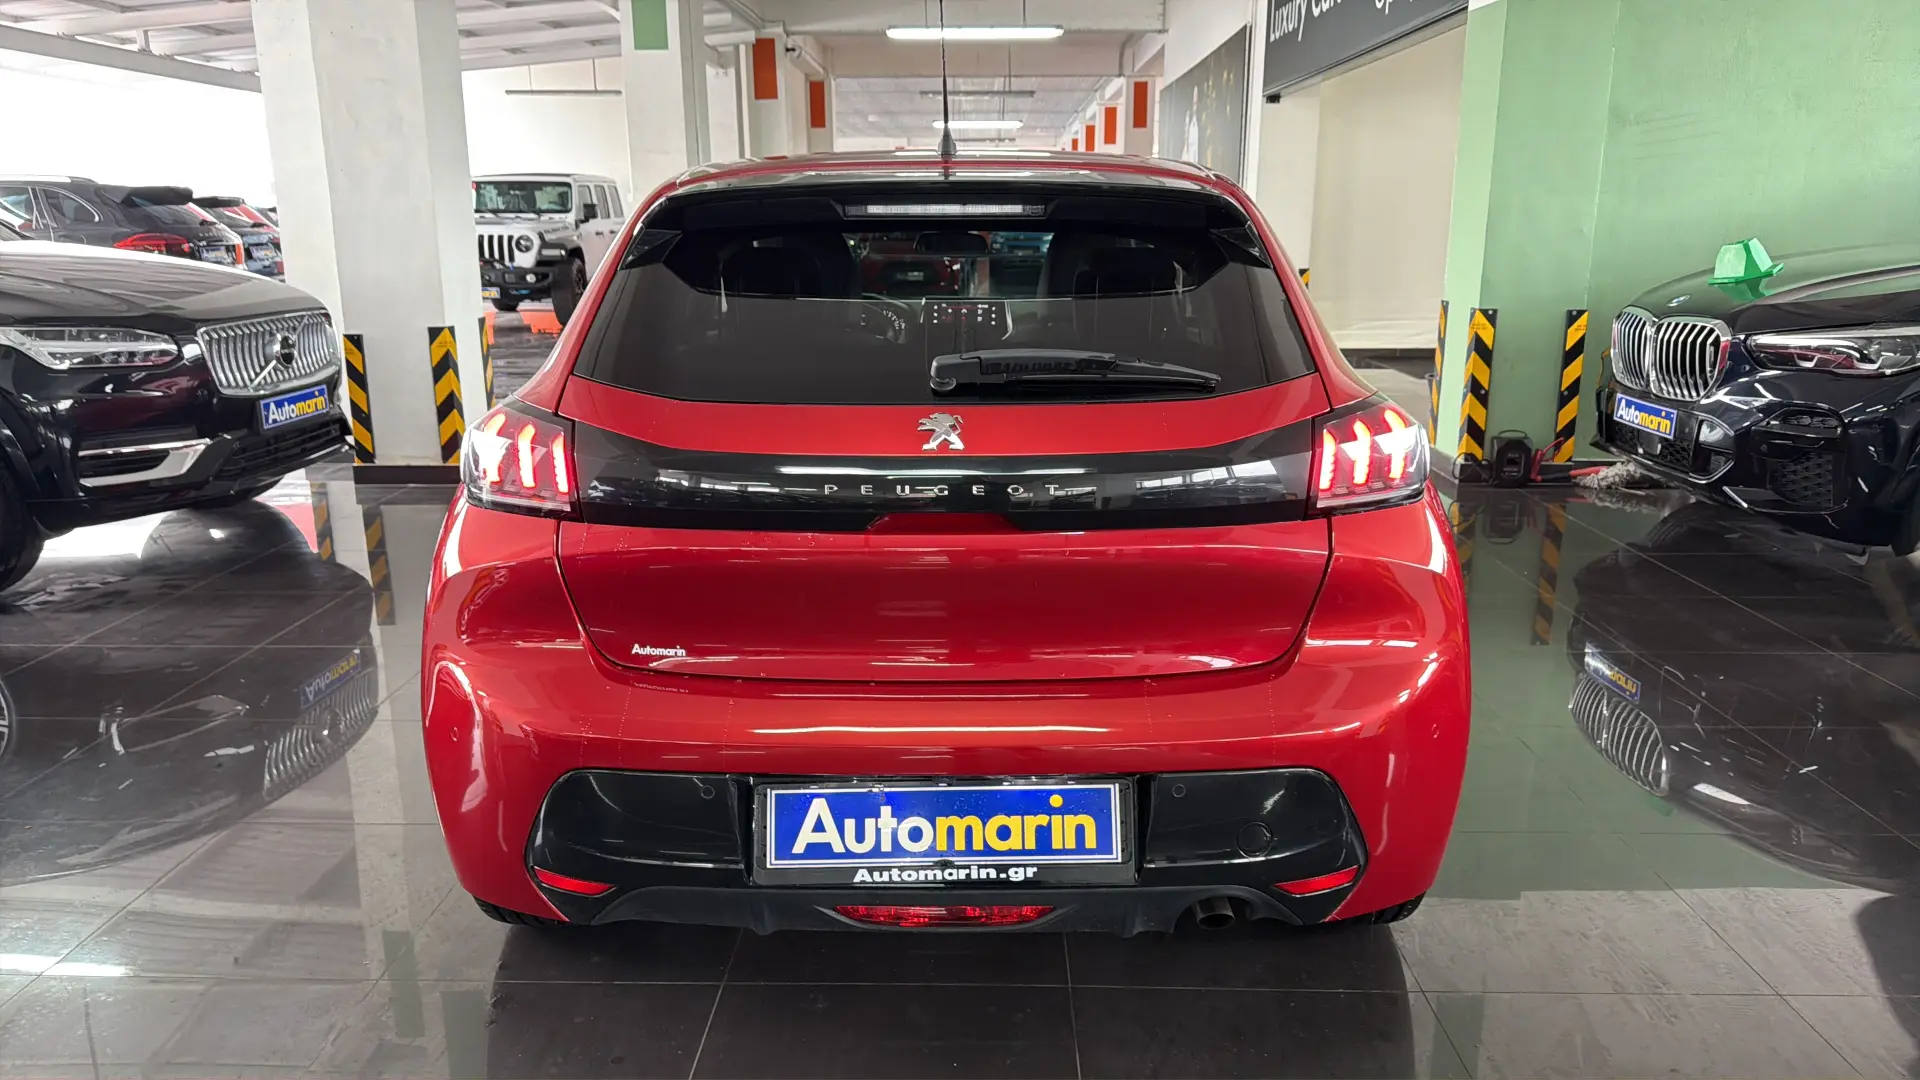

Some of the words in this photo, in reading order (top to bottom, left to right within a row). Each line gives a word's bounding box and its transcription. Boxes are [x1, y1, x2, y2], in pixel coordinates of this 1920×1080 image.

[1270, 0, 1307, 42] Luxury
[268, 391, 326, 424] Automarin
[1616, 398, 1671, 434] Automarin
[824, 484, 1060, 496] PEUGEOT
[631, 643, 686, 657] Automarin
[791, 793, 1097, 854] Automarin
[853, 865, 1037, 882] Automarin.gr
